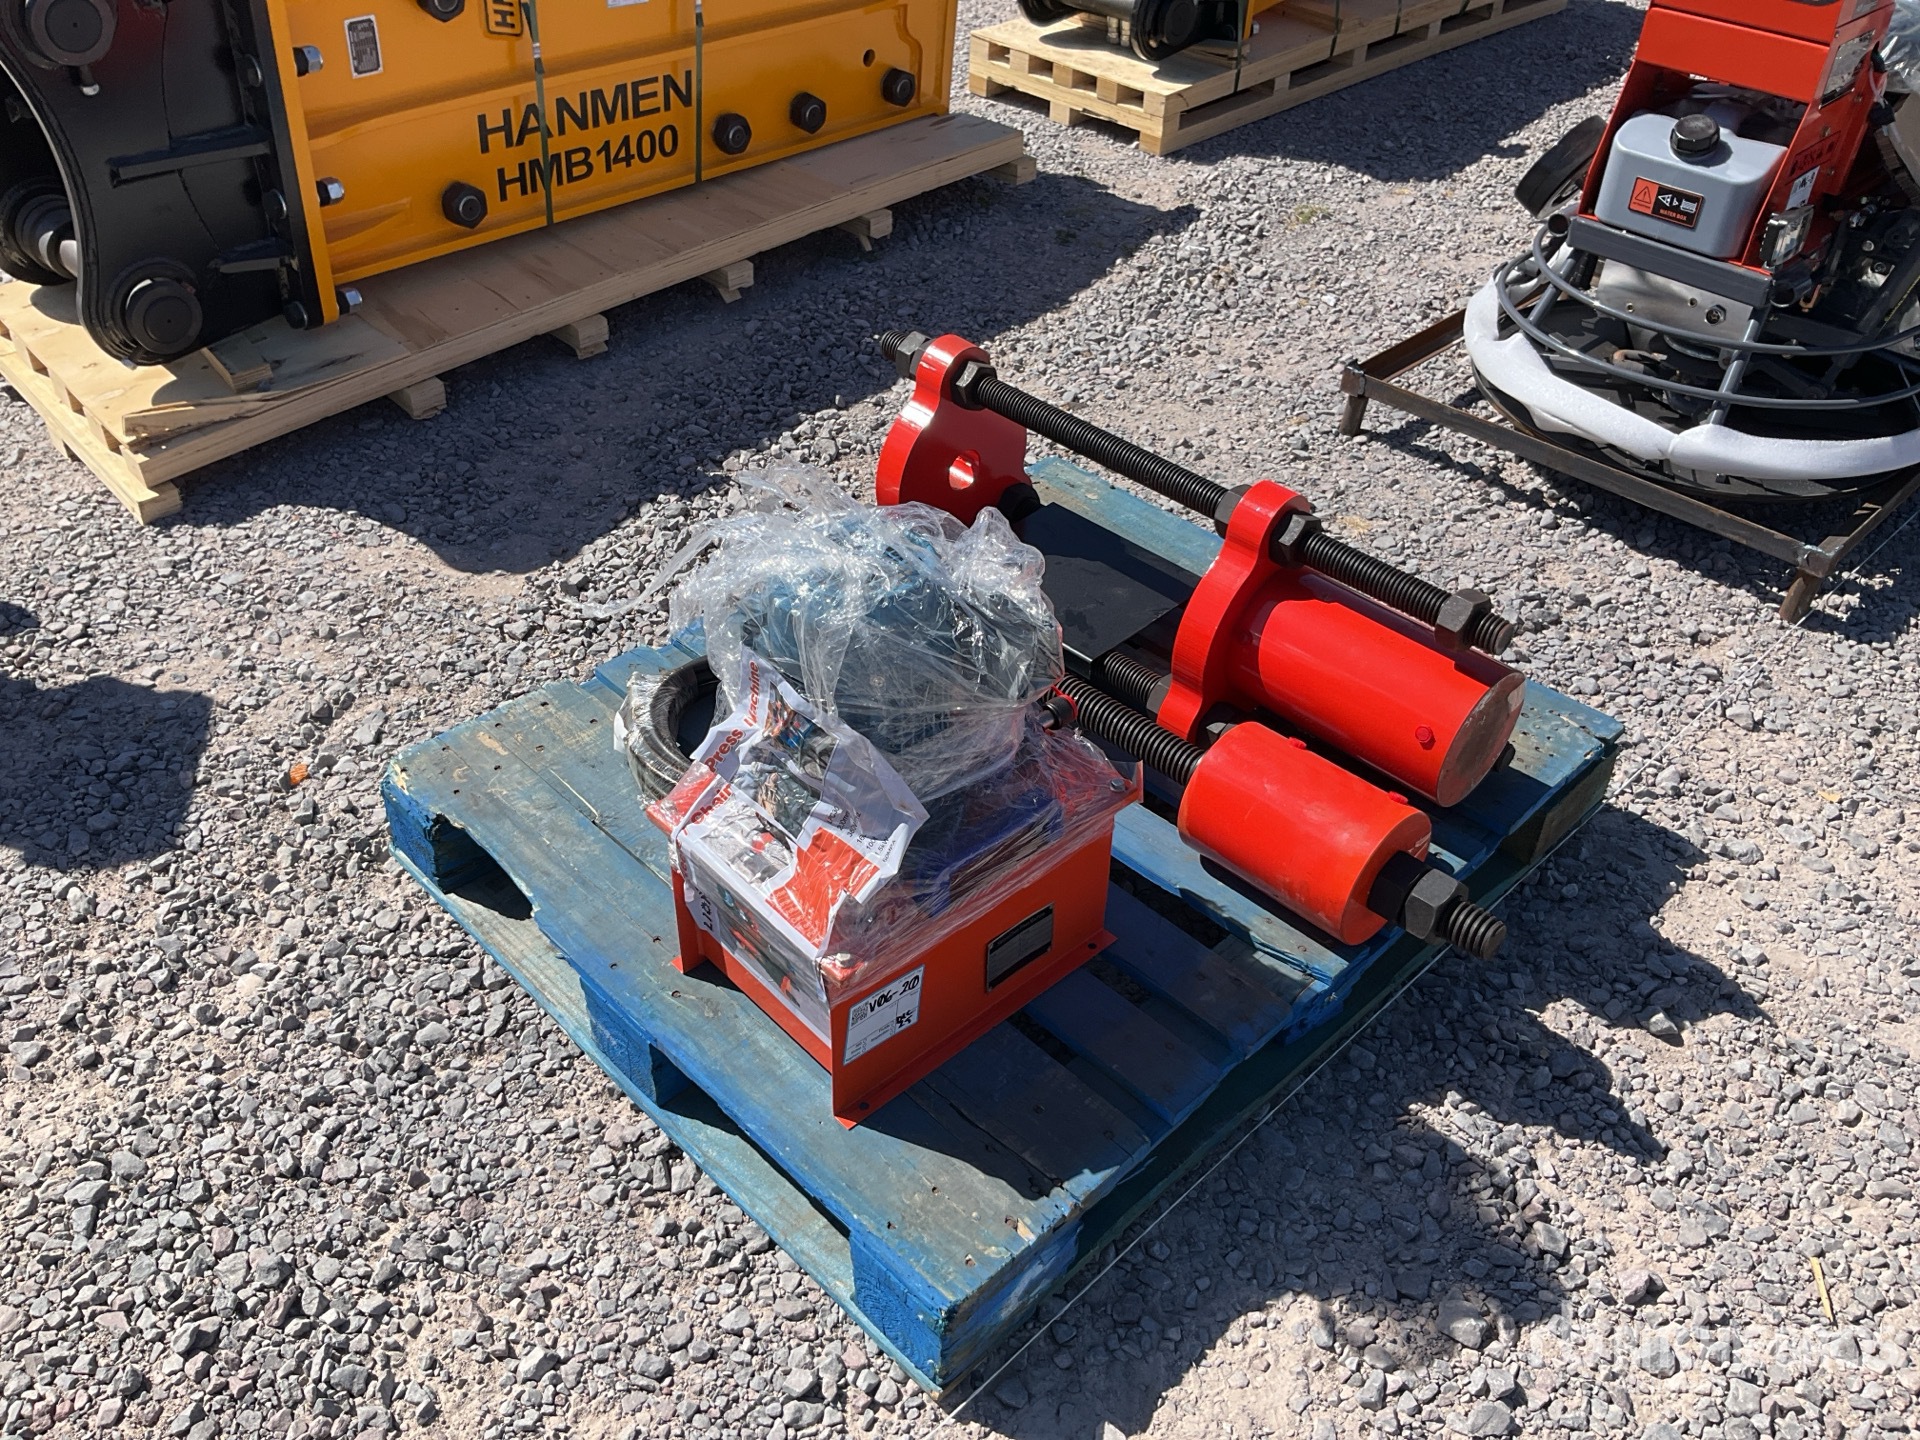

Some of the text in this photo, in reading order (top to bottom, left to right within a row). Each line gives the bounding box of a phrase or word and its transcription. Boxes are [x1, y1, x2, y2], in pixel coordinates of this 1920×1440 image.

[477, 70, 693, 154] HANMEN
[497, 124, 679, 202] HMB1400
[704, 728, 744, 773] Press
